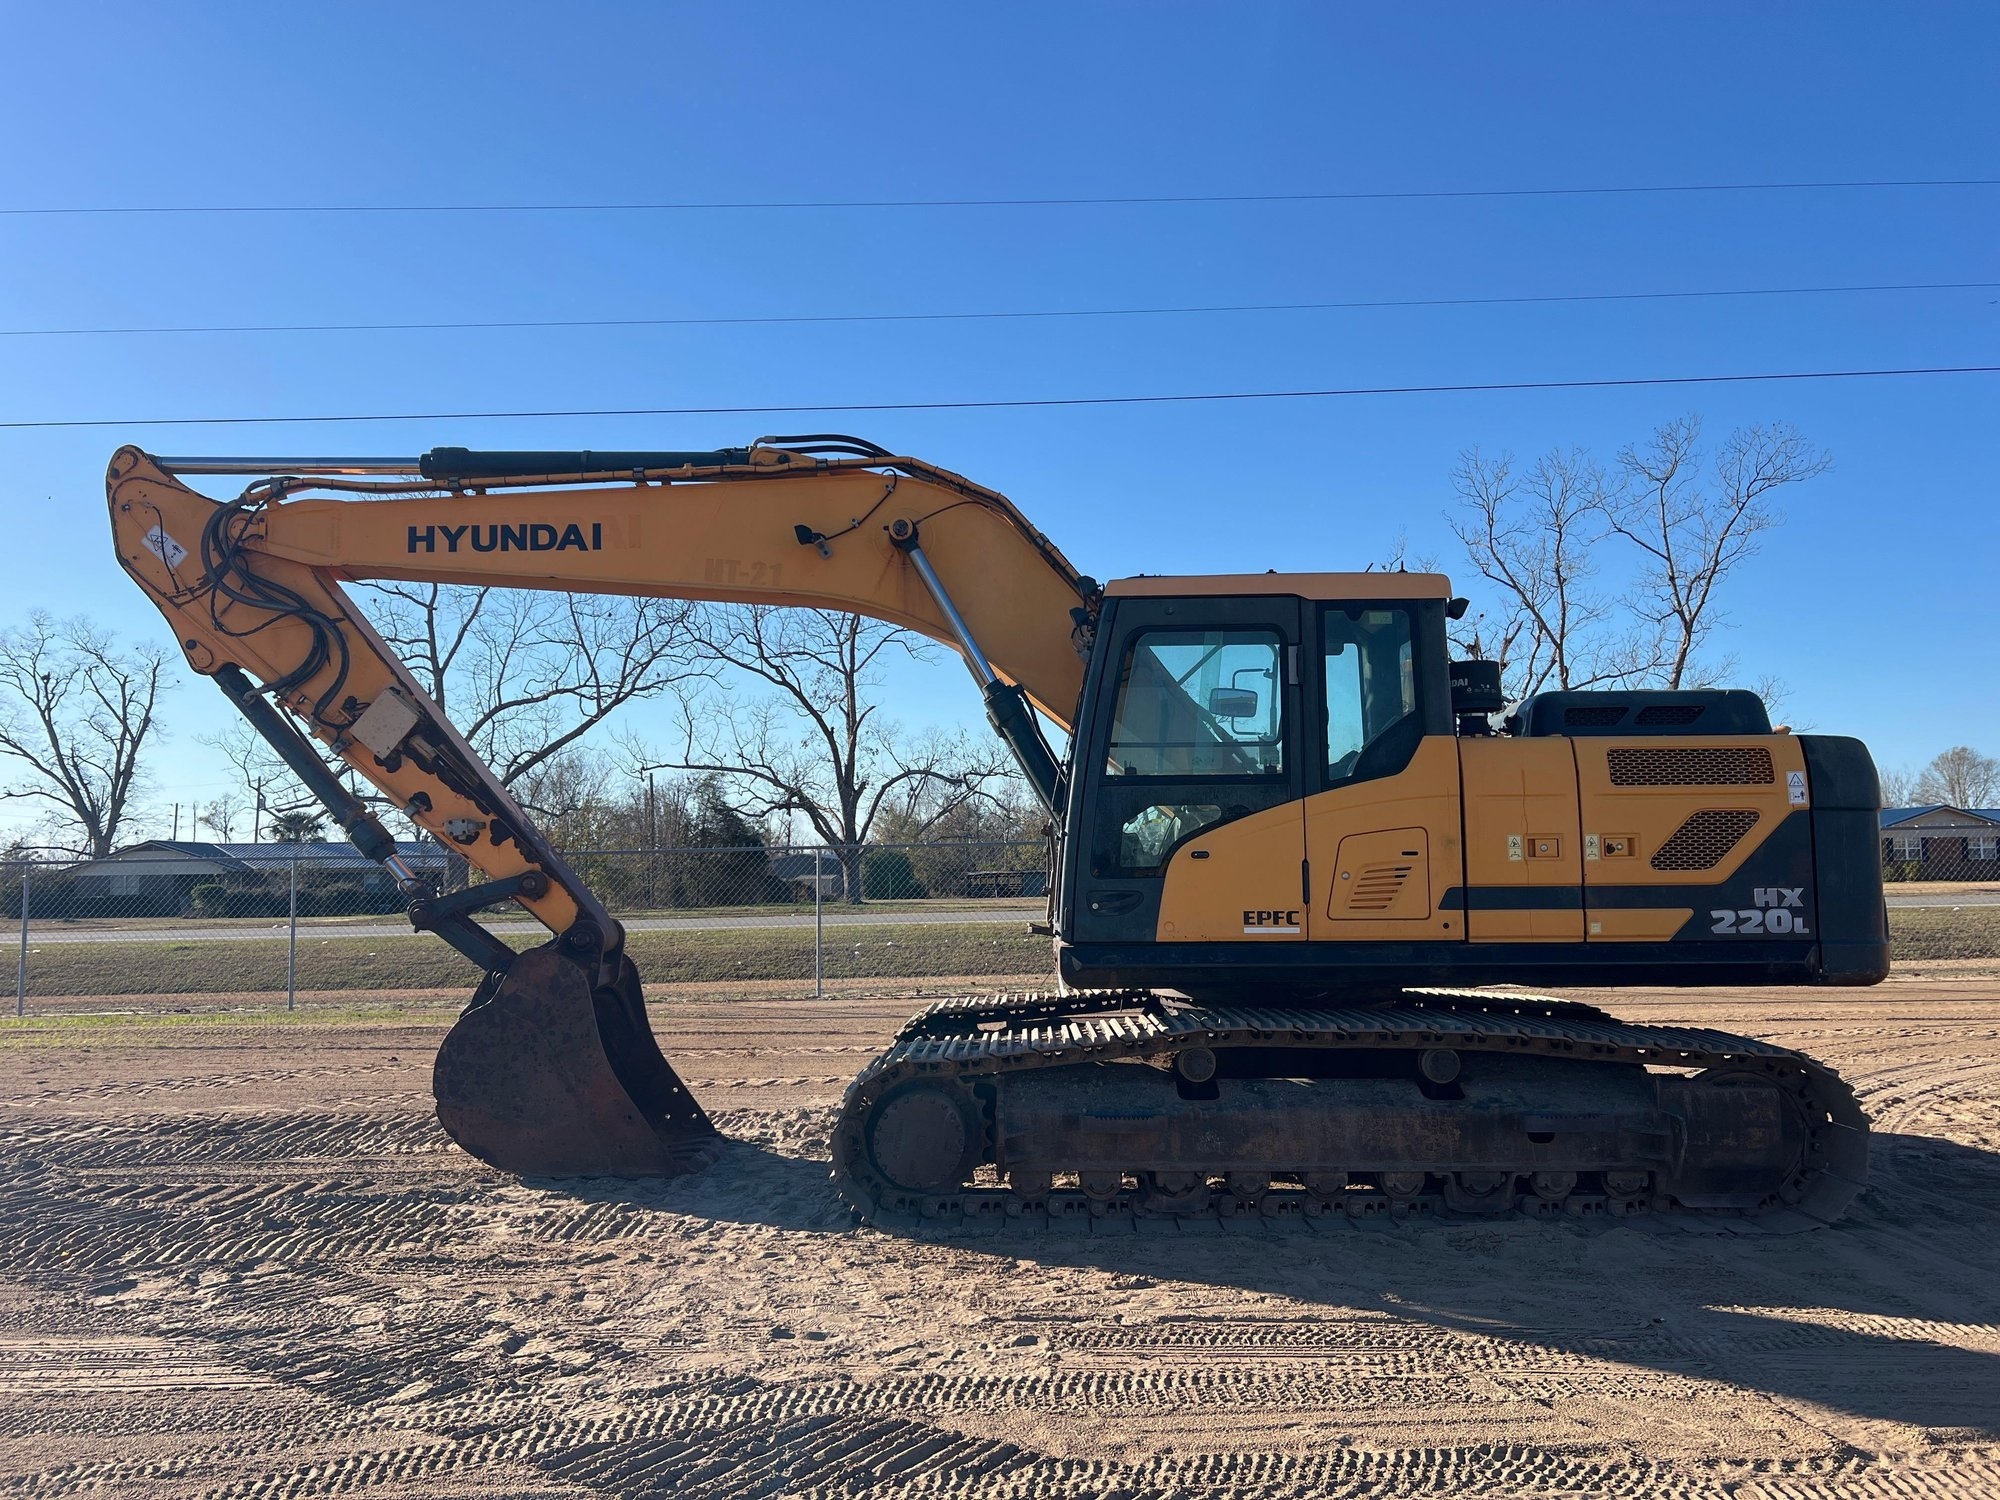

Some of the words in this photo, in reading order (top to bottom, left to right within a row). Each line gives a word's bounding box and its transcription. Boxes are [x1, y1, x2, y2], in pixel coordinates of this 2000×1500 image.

[407, 522, 602, 553] HYUNDAI
[1753, 888, 1804, 907] HX
[1243, 911, 1300, 925] EPFC
